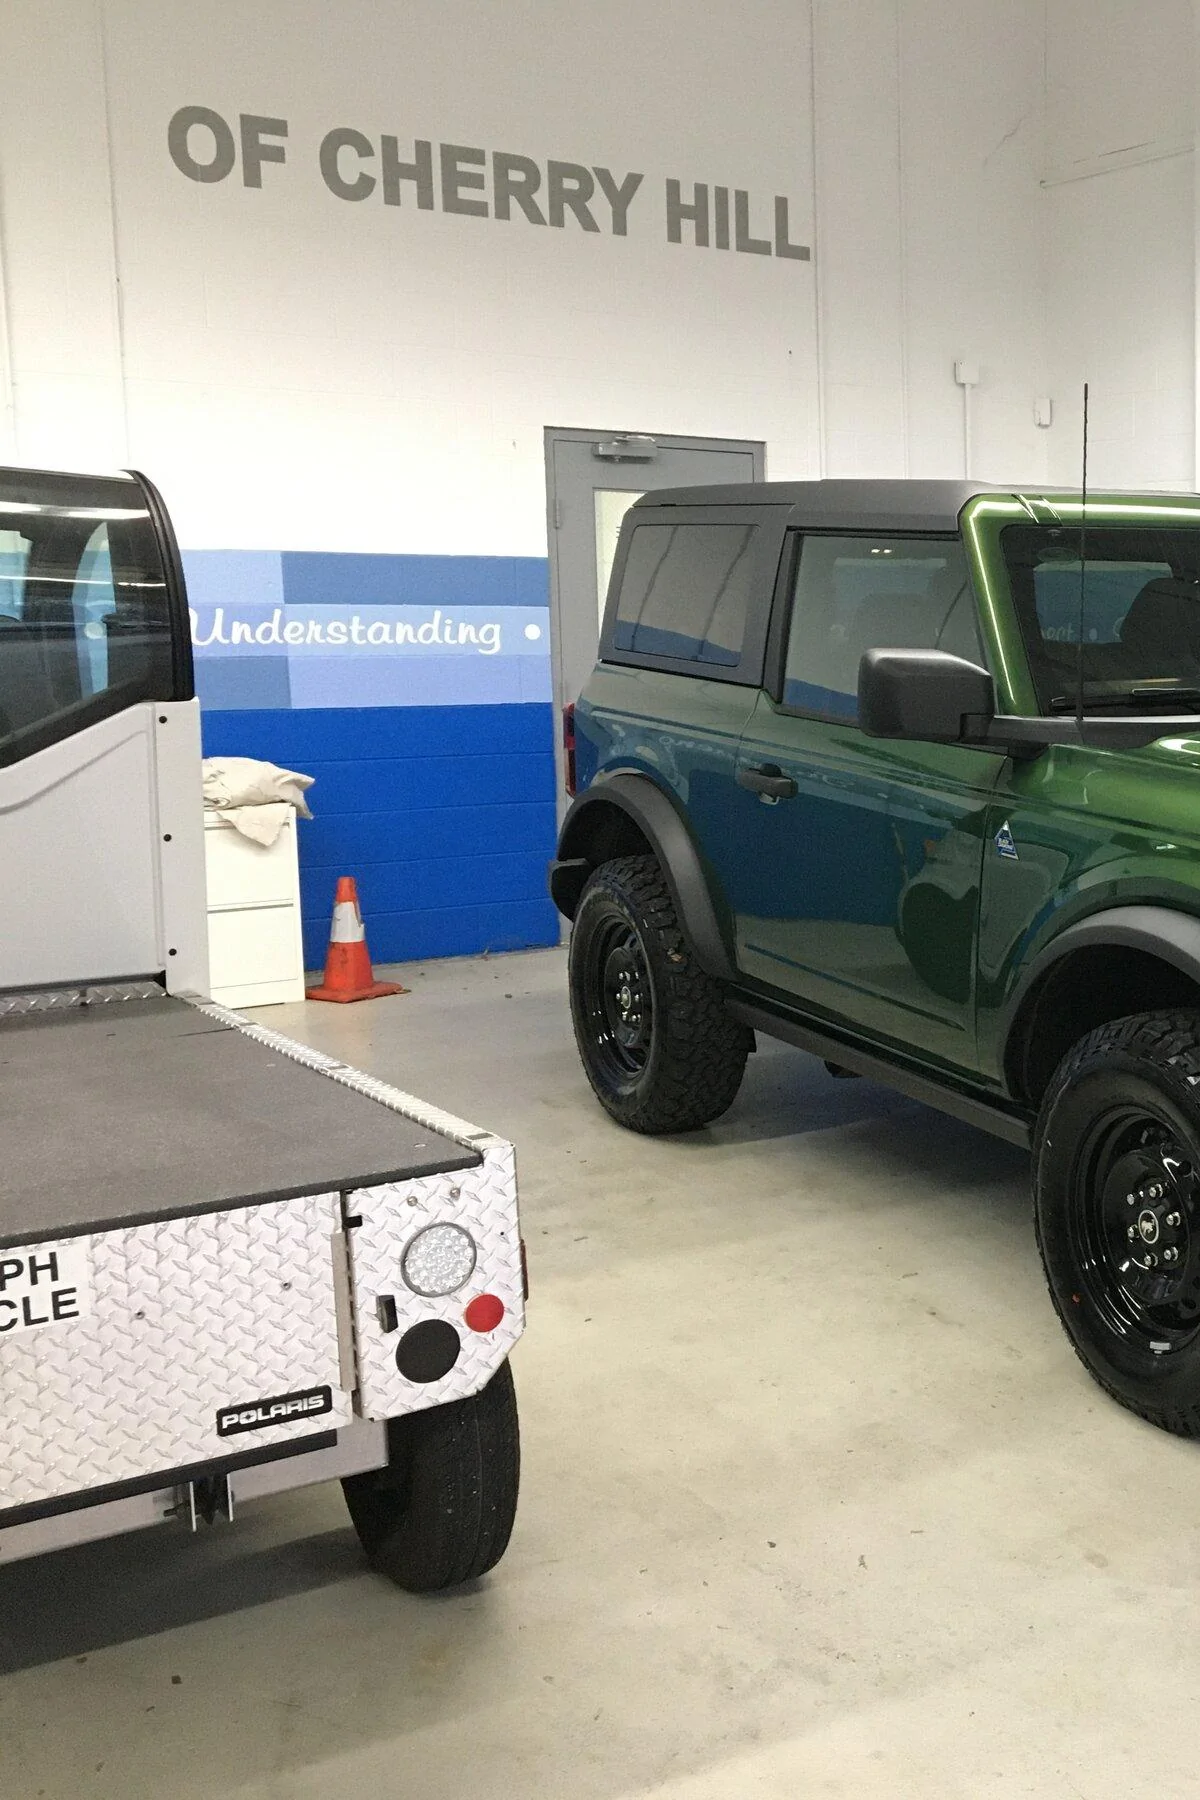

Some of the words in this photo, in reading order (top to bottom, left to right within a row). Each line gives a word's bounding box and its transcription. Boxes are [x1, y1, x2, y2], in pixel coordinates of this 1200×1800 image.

[167, 105, 289, 189] OF
[319, 127, 644, 237] CHERRY
[665, 178, 811, 262] HILL
[189, 607, 502, 655] Understanding
[222, 1394, 325, 1430] POLARIS
